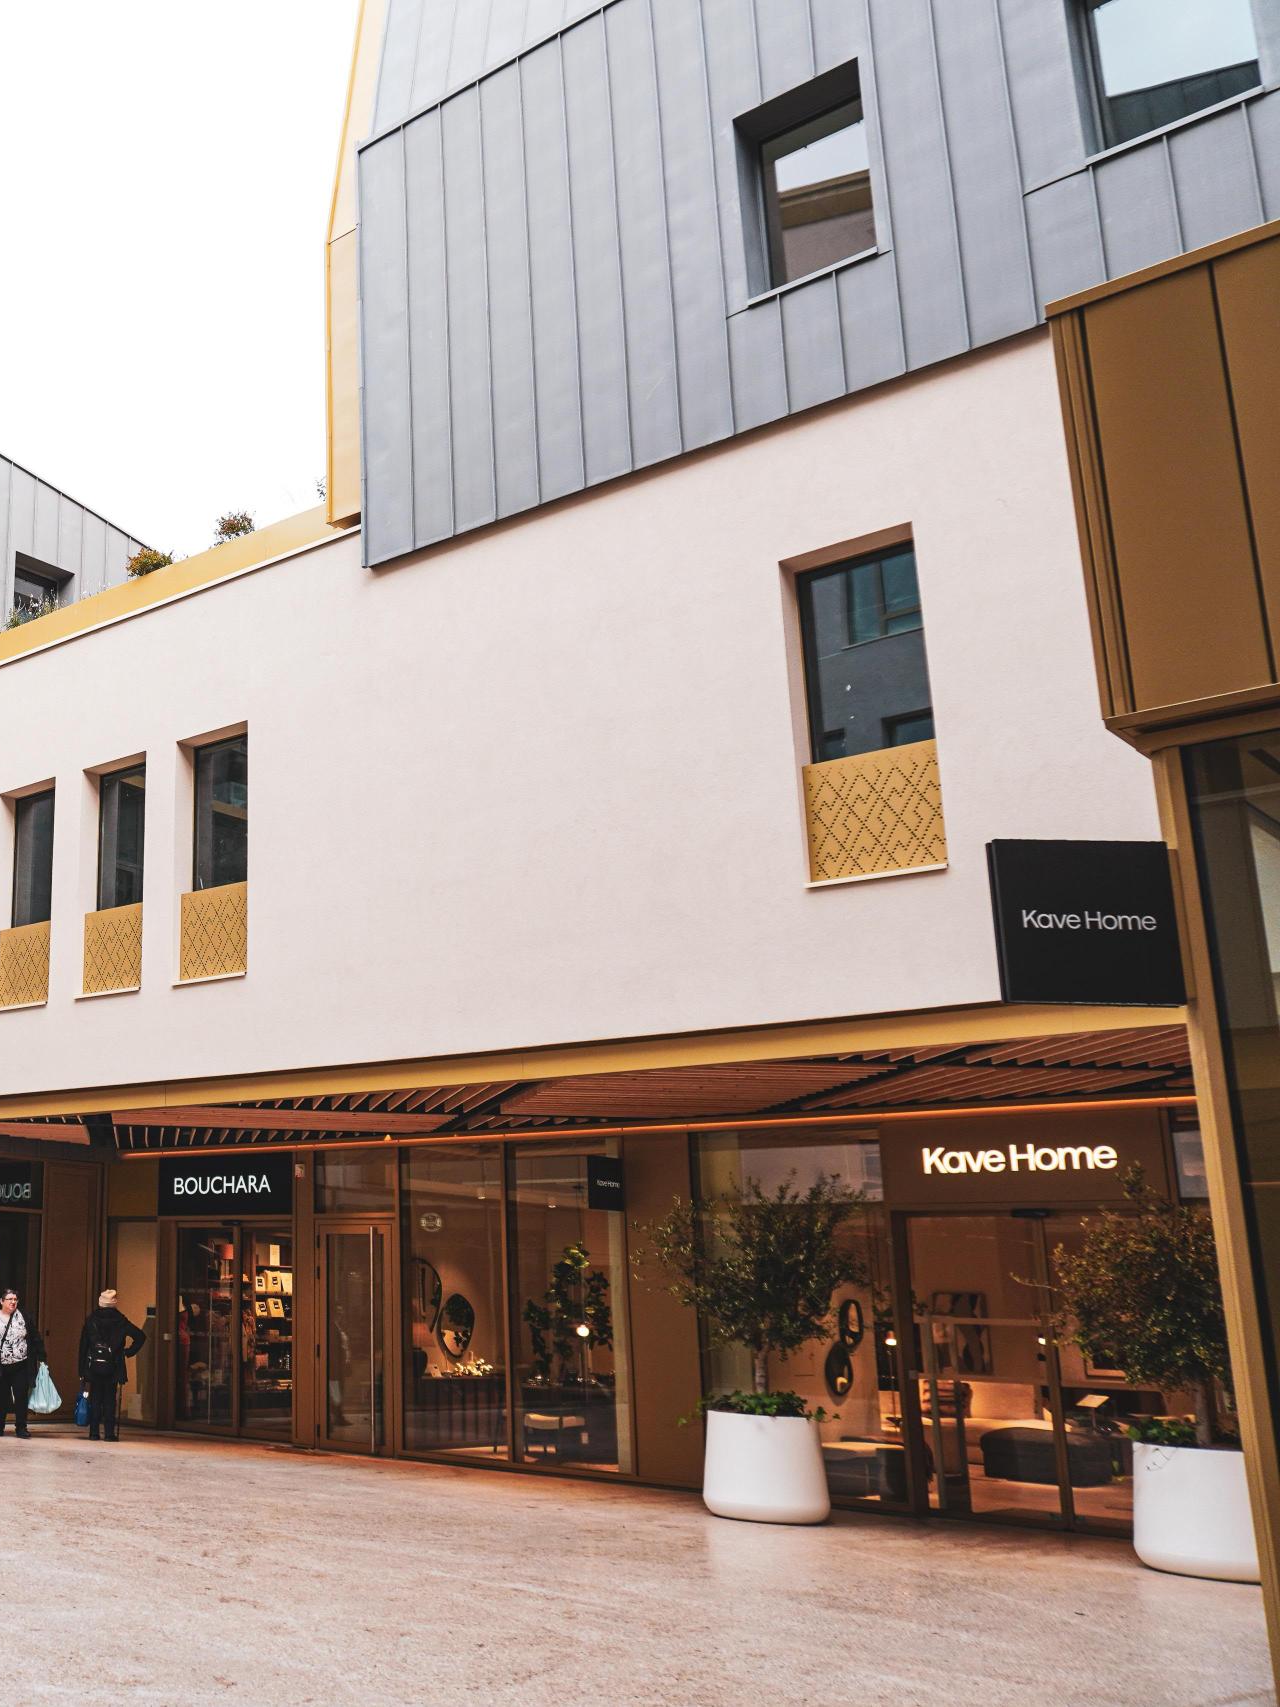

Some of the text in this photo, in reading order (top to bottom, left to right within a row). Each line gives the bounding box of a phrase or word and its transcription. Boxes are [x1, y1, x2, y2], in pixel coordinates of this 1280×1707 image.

[1021, 909, 1157, 931] Kave Home
[922, 1143, 1118, 1175] Kave Home
[173, 1174, 272, 1195] BOUCHARA
